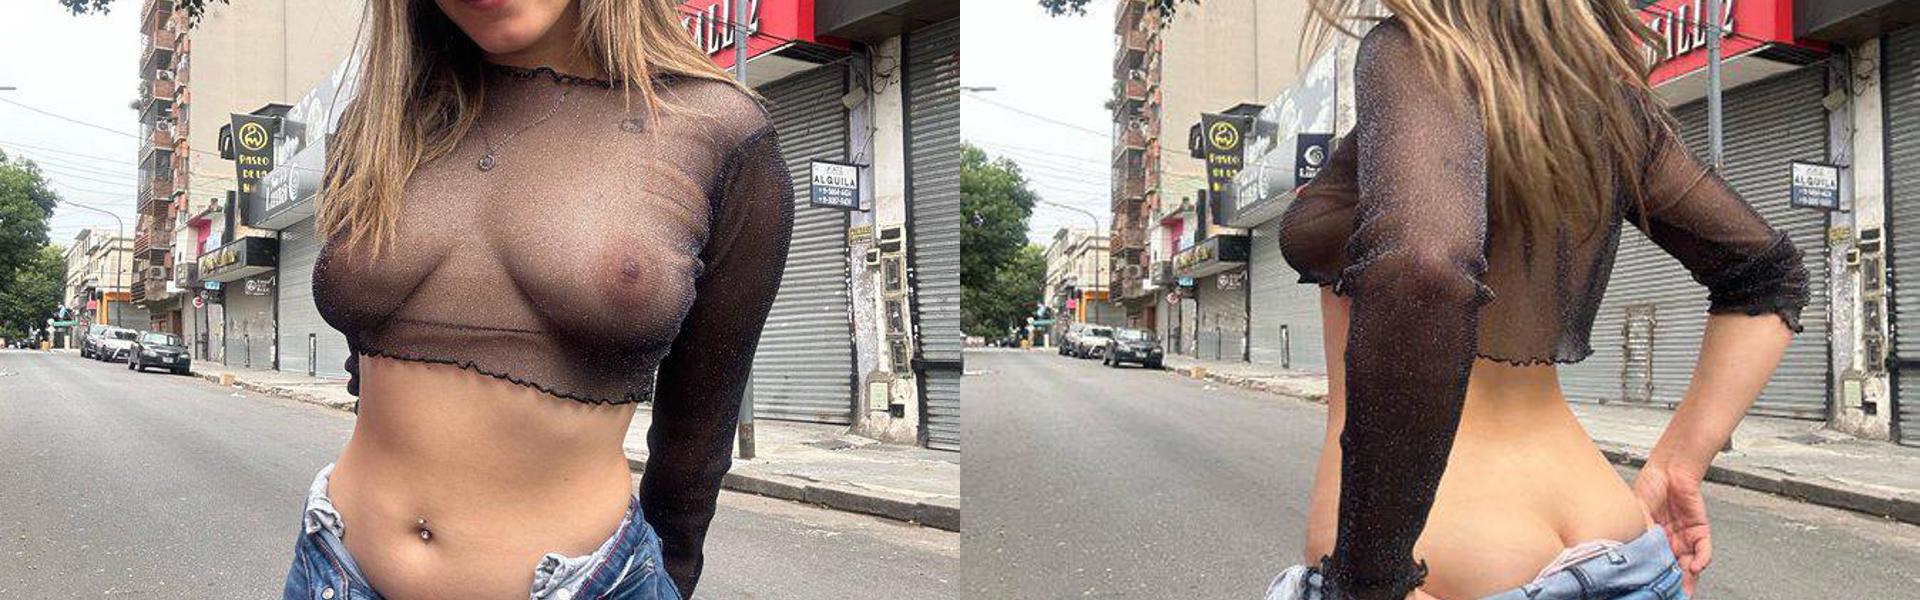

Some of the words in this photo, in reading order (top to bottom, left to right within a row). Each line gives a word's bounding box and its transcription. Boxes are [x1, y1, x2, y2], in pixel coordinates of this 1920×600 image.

[239, 154, 269, 165] PASEO
[243, 169, 254, 179] DE
[814, 175, 856, 187] ALQUILA
